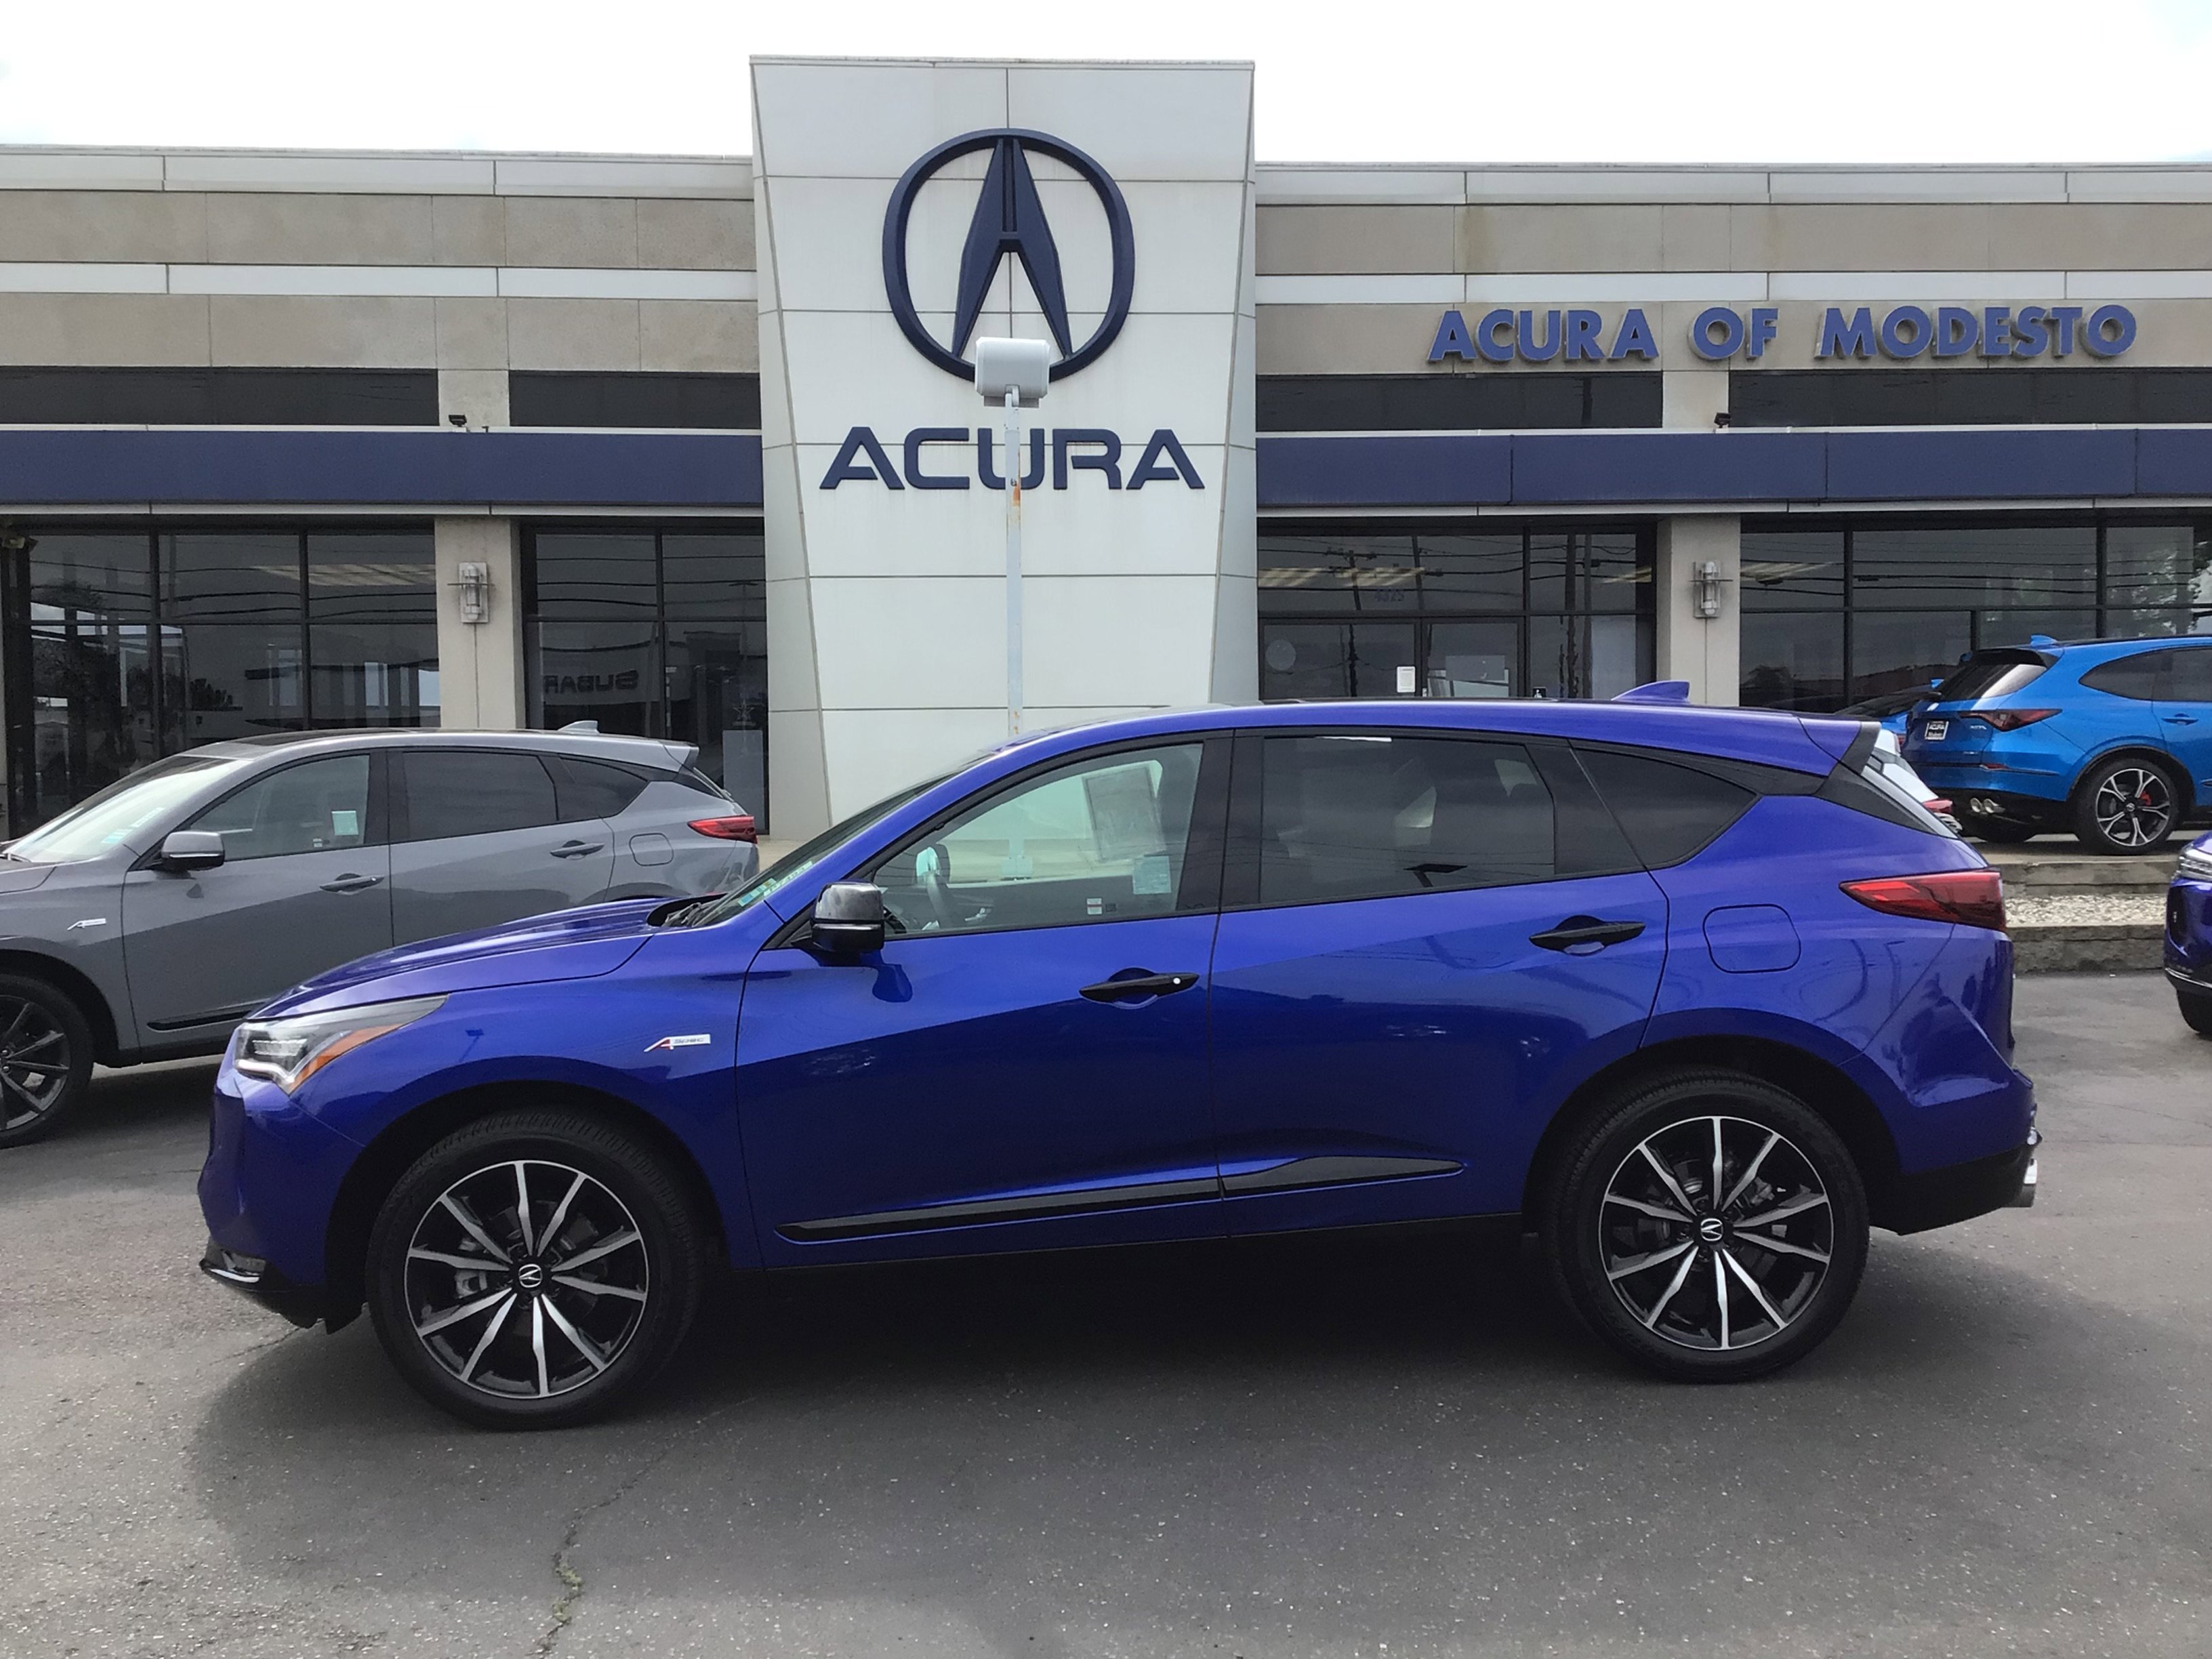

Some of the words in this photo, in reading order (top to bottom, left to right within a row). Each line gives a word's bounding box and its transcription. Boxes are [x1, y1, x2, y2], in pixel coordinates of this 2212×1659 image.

[1428, 308, 1659, 361] ACURA
[1689, 306, 1779, 360] OF
[1815, 304, 2137, 358] MODESTO
[819, 426, 1205, 490] ACURA
